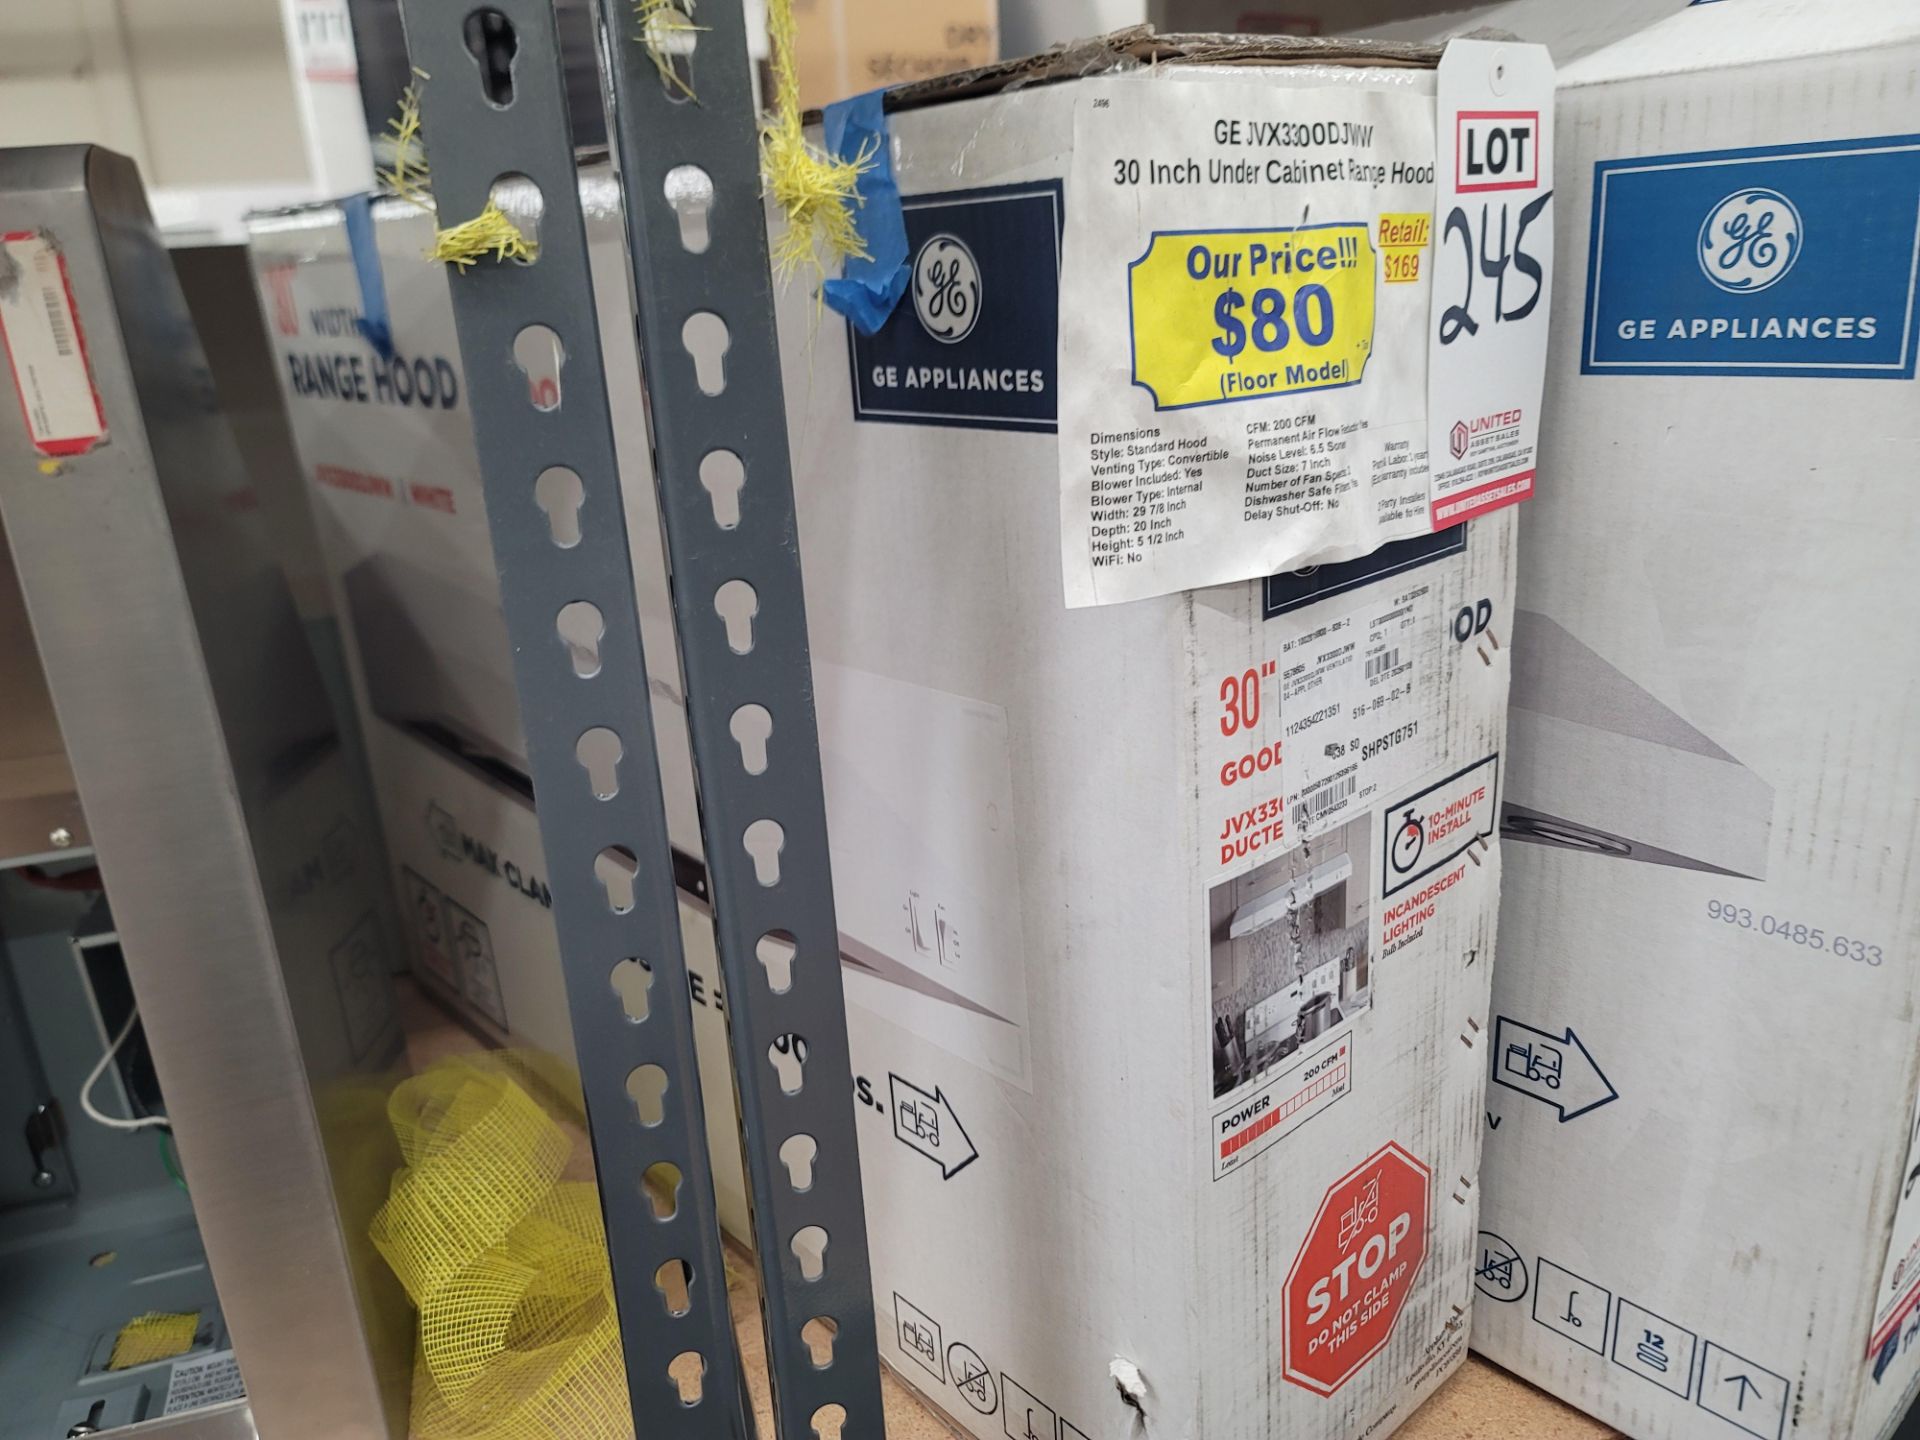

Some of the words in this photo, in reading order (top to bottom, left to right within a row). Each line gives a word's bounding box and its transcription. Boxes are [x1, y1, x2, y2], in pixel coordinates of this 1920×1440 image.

[1214, 119, 1241, 145] GE
[1467, 127, 1530, 176] LOT
[1114, 158, 1140, 185] 30
[1150, 157, 1200, 184] Inch
[1208, 157, 1261, 184] Under
[1266, 158, 1345, 185] Cabinet
[1391, 161, 1434, 184] Hood
[1378, 218, 1430, 244] Retail:
[1186, 244, 1242, 281] Our
[1249, 236, 1358, 276] Price!!!
[1384, 254, 1420, 279] $169
[1438, 191, 1553, 346] 245
[1211, 283, 1335, 365] $80
[1617, 319, 1656, 340] GE
[1667, 317, 1878, 340] APPLIANCES
[287, 355, 369, 402] RANGE
[372, 355, 459, 410] HOOD
[872, 366, 899, 388] GE
[905, 366, 1045, 393] APPLIANCES
[1219, 371, 1278, 400] (Floor
[1285, 358, 1349, 385] Model)
[1246, 422, 1271, 435] CFM:
[1273, 418, 1292, 431] 200
[1294, 414, 1316, 427] CFM
[1470, 408, 1522, 433] UNITED
[1090, 427, 1161, 445] Dimensions
[1248, 433, 1301, 449] Permanent
[1302, 429, 1316, 441] Air
[1318, 425, 1340, 438] Flow
[1495, 429, 1520, 442] SALES
[1090, 447, 1125, 462] Style:
[1127, 439, 1175, 457] Standard
[1177, 436, 1208, 449] Hood
[1248, 451, 1277, 465] Noise
[1278, 446, 1308, 460] Level:
[1309, 442, 1325, 455] 6.5
[1091, 461, 1136, 477] Venting
[1138, 457, 1166, 473] Type:
[1168, 450, 1230, 467] Convertible
[1246, 465, 1272, 479] Duct
[1274, 461, 1300, 474] Size:
[1302, 459, 1308, 471] 7
[1309, 456, 1332, 470] Inch
[1091, 477, 1133, 492] Blower
[1135, 471, 1183, 487] Included:
[1184, 467, 1204, 479] Yes
[1245, 477, 1287, 493] Number
[1290, 474, 1302, 487] of
[1302, 472, 1323, 486] Fan
[1091, 492, 1133, 507] Blower
[1136, 487, 1166, 502] Type:
[1167, 481, 1204, 497] Internal
[1244, 491, 1307, 508] Dishwasher
[1308, 484, 1332, 497] Safe
[1091, 507, 1130, 522] Width:
[1132, 506, 1147, 518] 29
[1149, 502, 1166, 516] 7/8
[1167, 499, 1188, 513] Inch
[1244, 507, 1273, 523] Delay
[1276, 502, 1325, 517] Shut-Off:
[1327, 499, 1340, 511] No
[1091, 524, 1131, 540] Depth:
[1134, 521, 1147, 533] 20
[1150, 517, 1172, 531] Inch
[1091, 538, 1135, 554] Height:
[1137, 536, 1144, 547] 5
[1148, 532, 1163, 545] 1/2
[1165, 529, 1185, 543] Inch
[1092, 554, 1124, 567] WiFi:
[1127, 553, 1143, 564] No
[1449, 597, 1493, 644] OD
[1283, 639, 1297, 652] BAT:
[1219, 659, 1276, 737] 30"
[1361, 720, 1418, 761] SHPSTG751
[1428, 786, 1486, 828] 10-MINUTE
[1428, 810, 1472, 845] INSTALL
[1383, 864, 1466, 926] INCANDESCENT
[1383, 903, 1436, 945] LIGHTING
[1707, 899, 1883, 967] 993.0485.633
[1382, 944, 1397, 960] Bulb
[1397, 926, 1424, 950] Included
[1303, 1066, 1320, 1082] 200
[1321, 1052, 1339, 1070] CFM
[1221, 1095, 1271, 1134] POWER
[1306, 1212, 1411, 1326] STOP
[1308, 1329, 1329, 1356] DO
[1332, 1300, 1361, 1335] NOT
[1363, 1261, 1408, 1306] CLAMP
[1328, 1320, 1358, 1355] THIS
[1360, 1291, 1390, 1327] SIDE
[1642, 1329, 1665, 1351] 12
